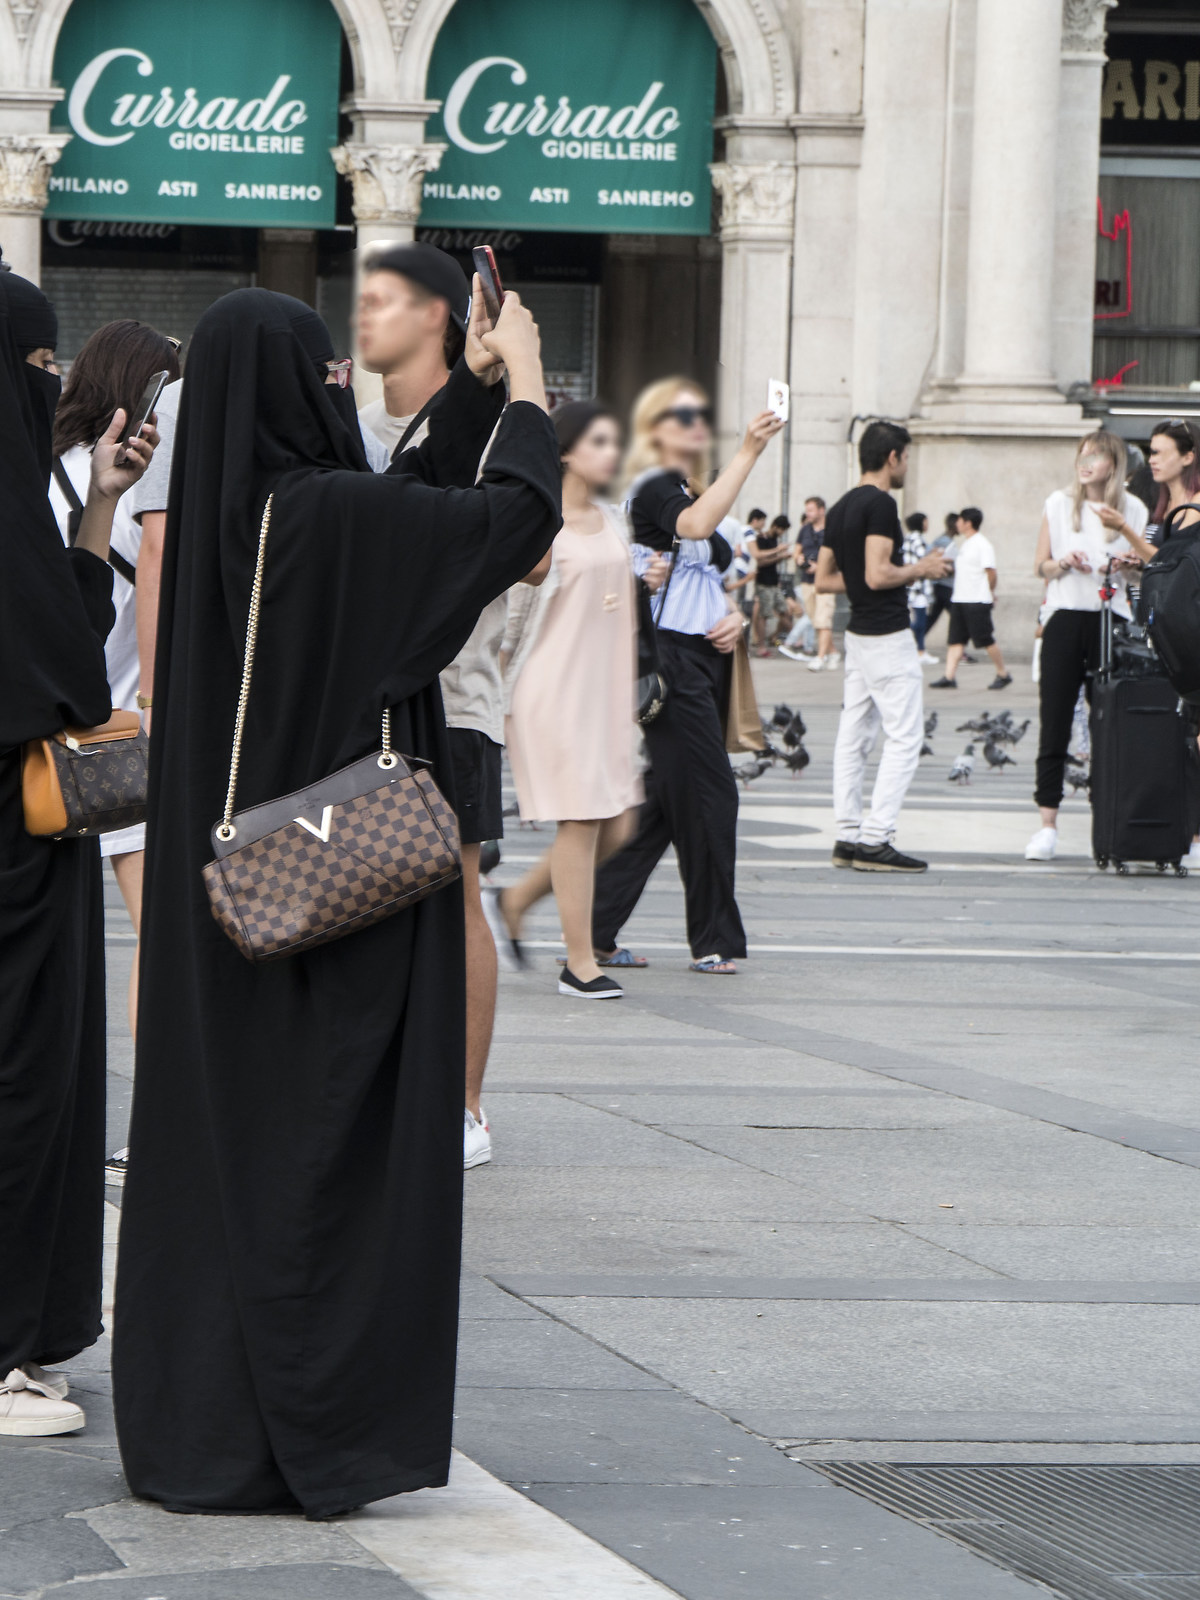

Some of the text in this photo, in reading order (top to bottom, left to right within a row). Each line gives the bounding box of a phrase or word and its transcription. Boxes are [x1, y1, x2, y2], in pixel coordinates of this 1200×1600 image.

[67, 47, 308, 147] Currado
[442, 56, 680, 154] Currado
[168, 130, 305, 155] GIOIELLERIE
[541, 138, 678, 162] GIOIELLERIE
[50, 176, 322, 202] MILANO ASTI SANREMO
[424, 182, 694, 208] MILANO ASTI SANREMO
